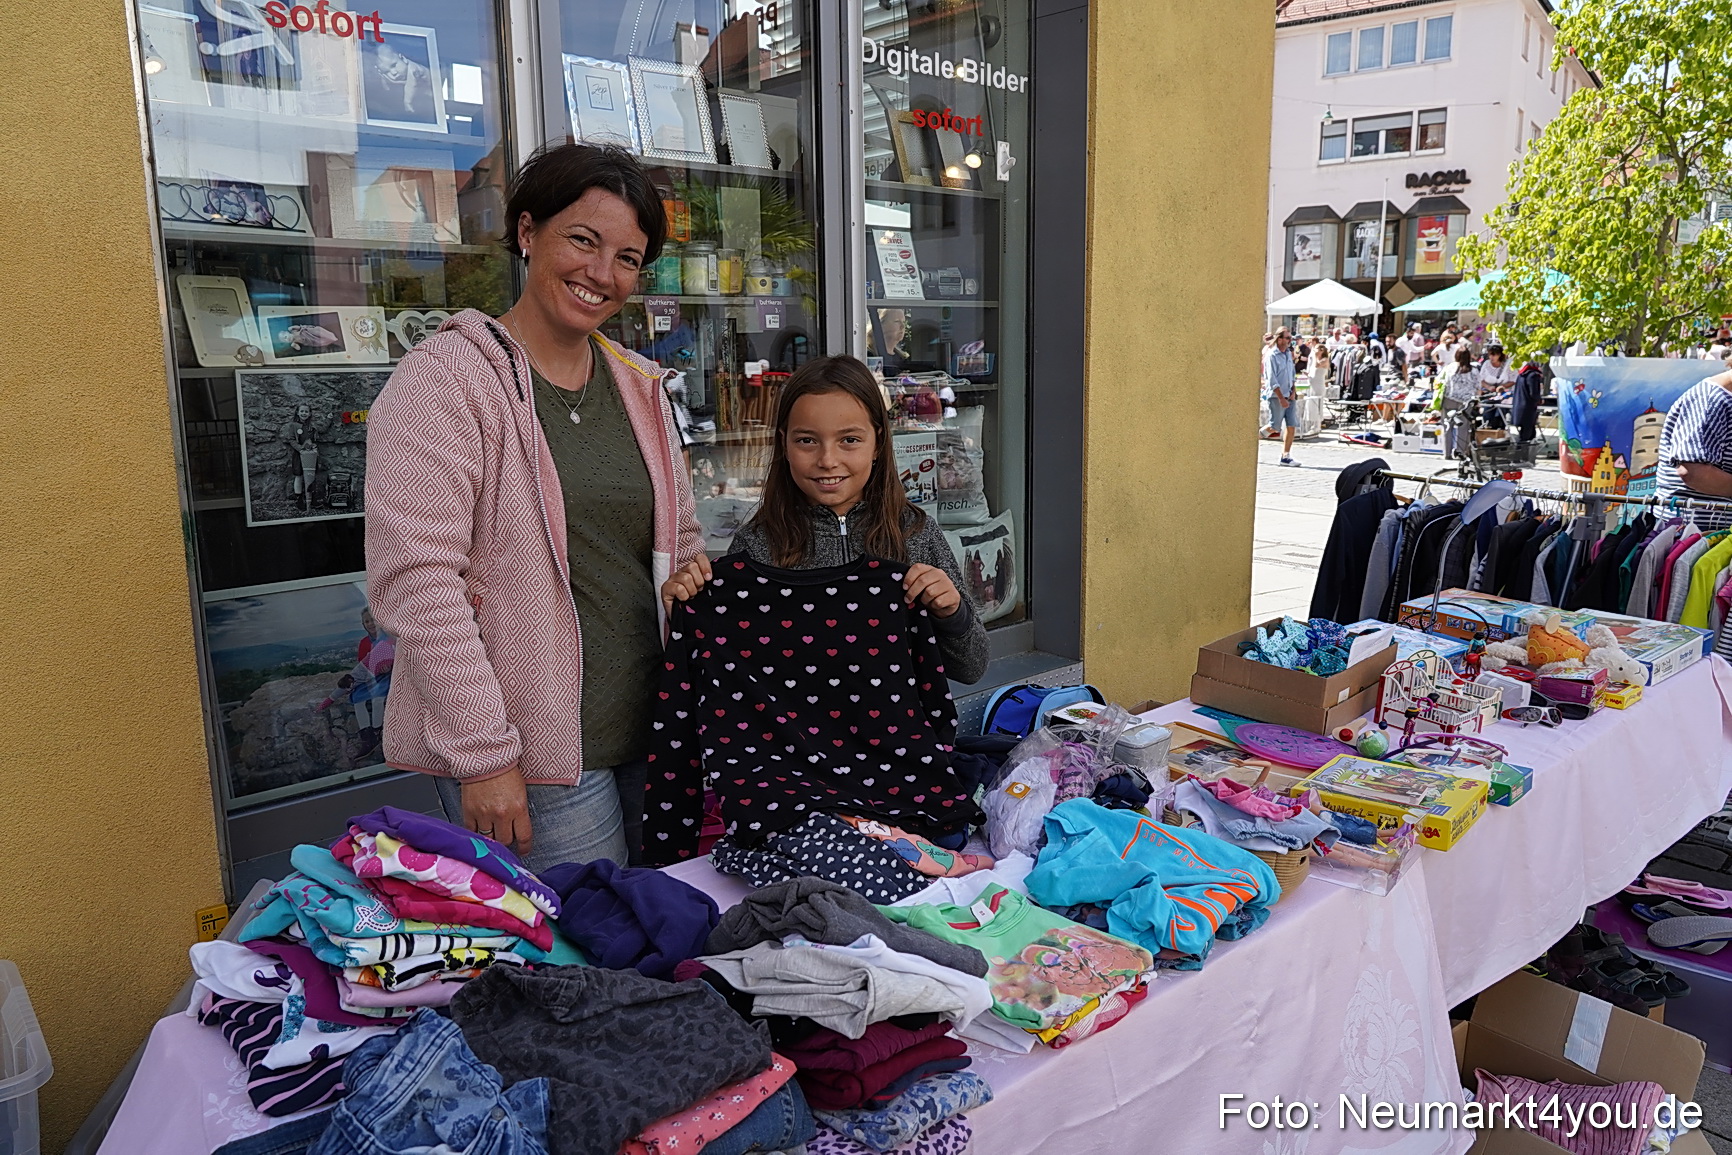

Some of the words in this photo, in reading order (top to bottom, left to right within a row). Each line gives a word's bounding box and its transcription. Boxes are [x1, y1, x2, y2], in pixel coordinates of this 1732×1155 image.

[265, 0, 385, 43] sofort
[862, 37, 955, 79] Digitale
[963, 58, 1028, 93] Bilder
[913, 108, 984, 136] sofort
[1406, 169, 1471, 188] RACKL
[663, 308, 676, 316] 9,50
[201, 913, 214, 921] GAS
